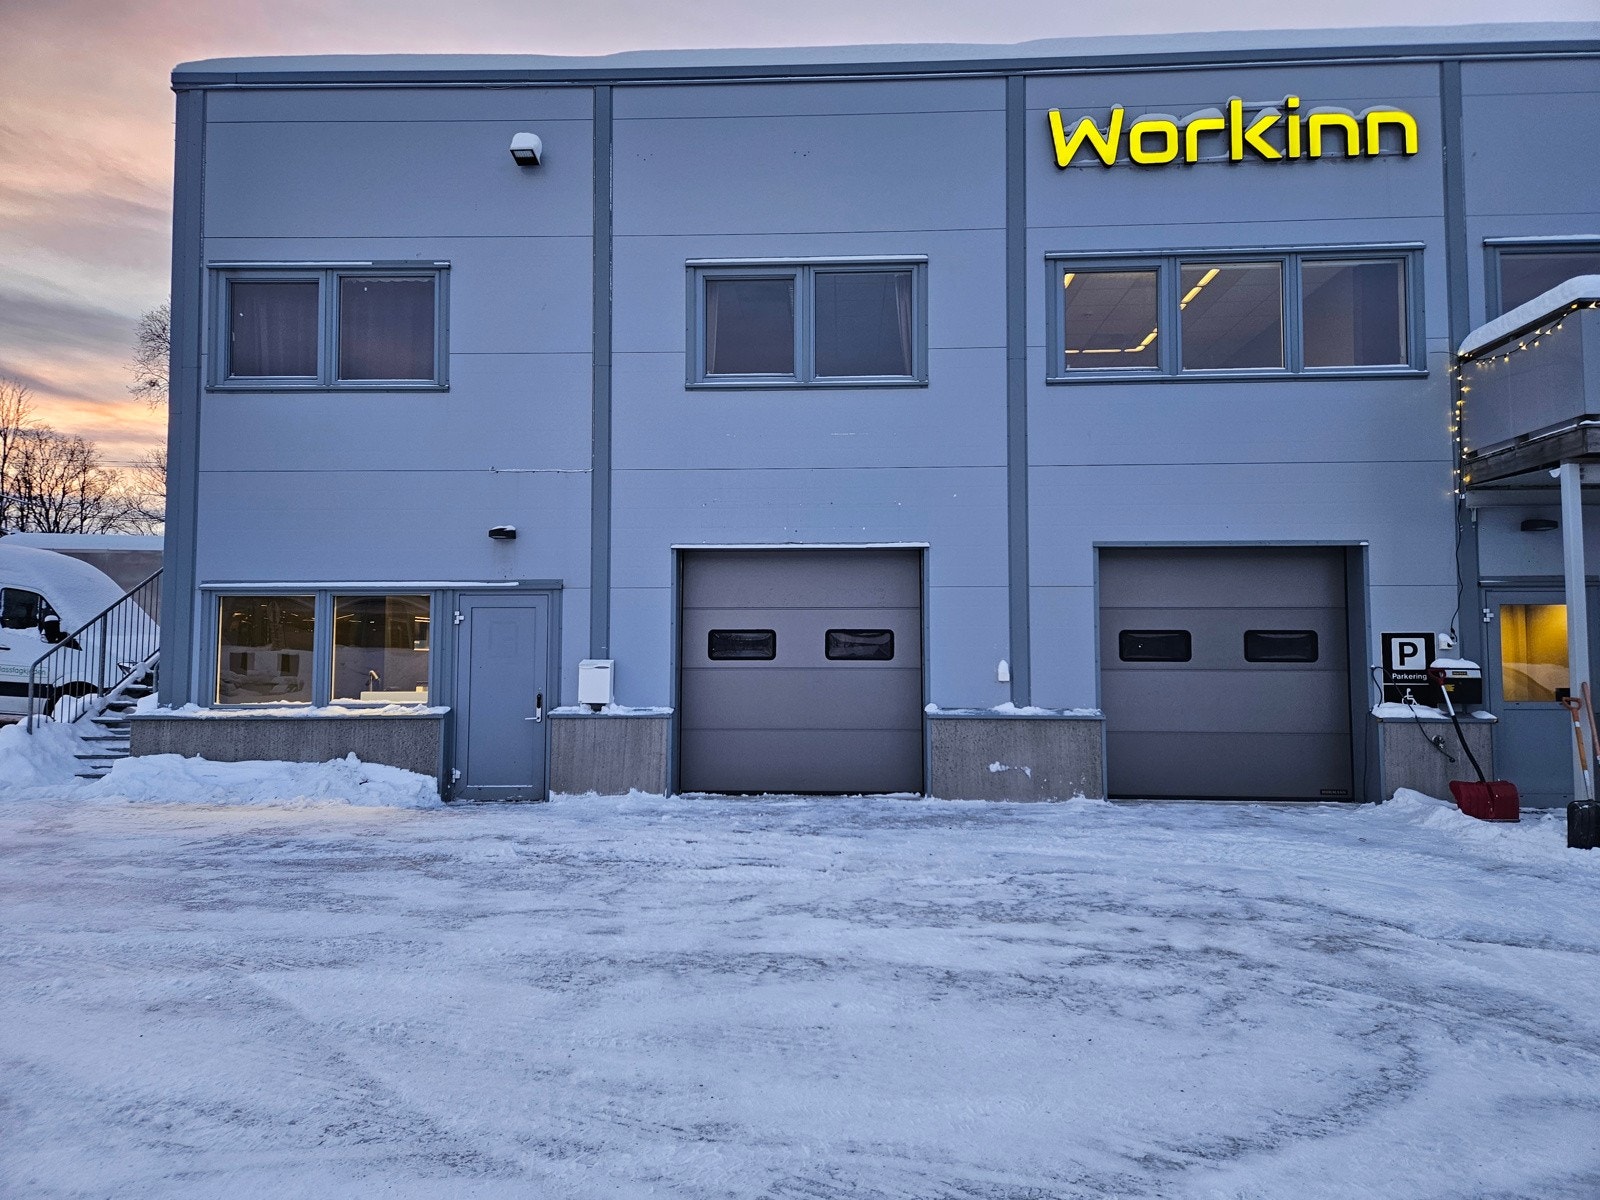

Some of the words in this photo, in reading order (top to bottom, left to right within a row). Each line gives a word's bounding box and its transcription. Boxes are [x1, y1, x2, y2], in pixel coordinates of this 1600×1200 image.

[1048, 96, 1418, 167] Workinn
[1398, 642, 1418, 666] P
[1391, 672, 1428, 681] Parkering
